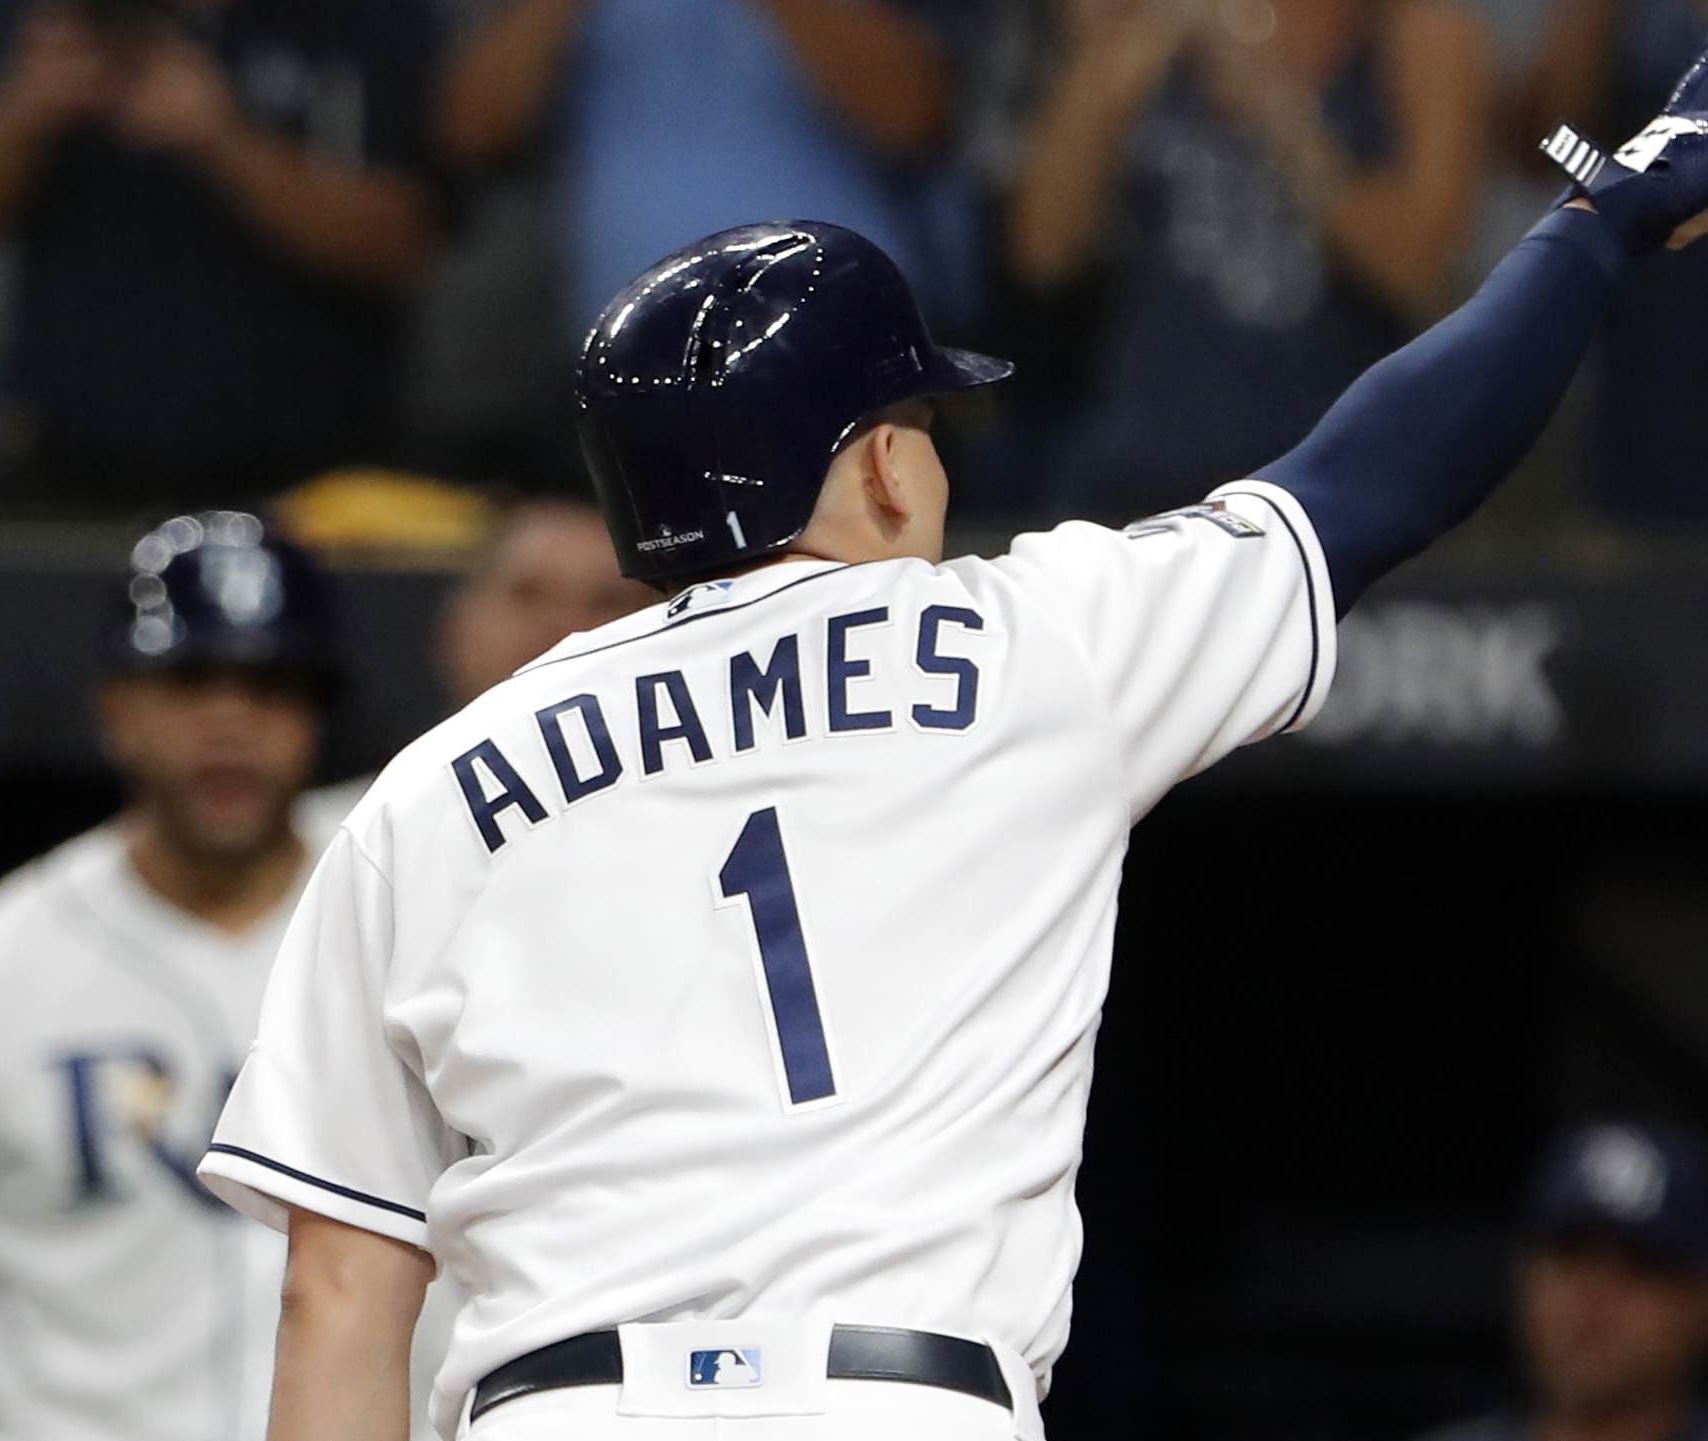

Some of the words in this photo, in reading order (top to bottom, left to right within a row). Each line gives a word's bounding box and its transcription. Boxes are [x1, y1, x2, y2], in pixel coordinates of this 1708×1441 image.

[636, 530, 704, 551] POSTSEASON
[726, 510, 747, 549] 1
[450, 603, 986, 855] ADAMES
[717, 804, 839, 1107] 1
